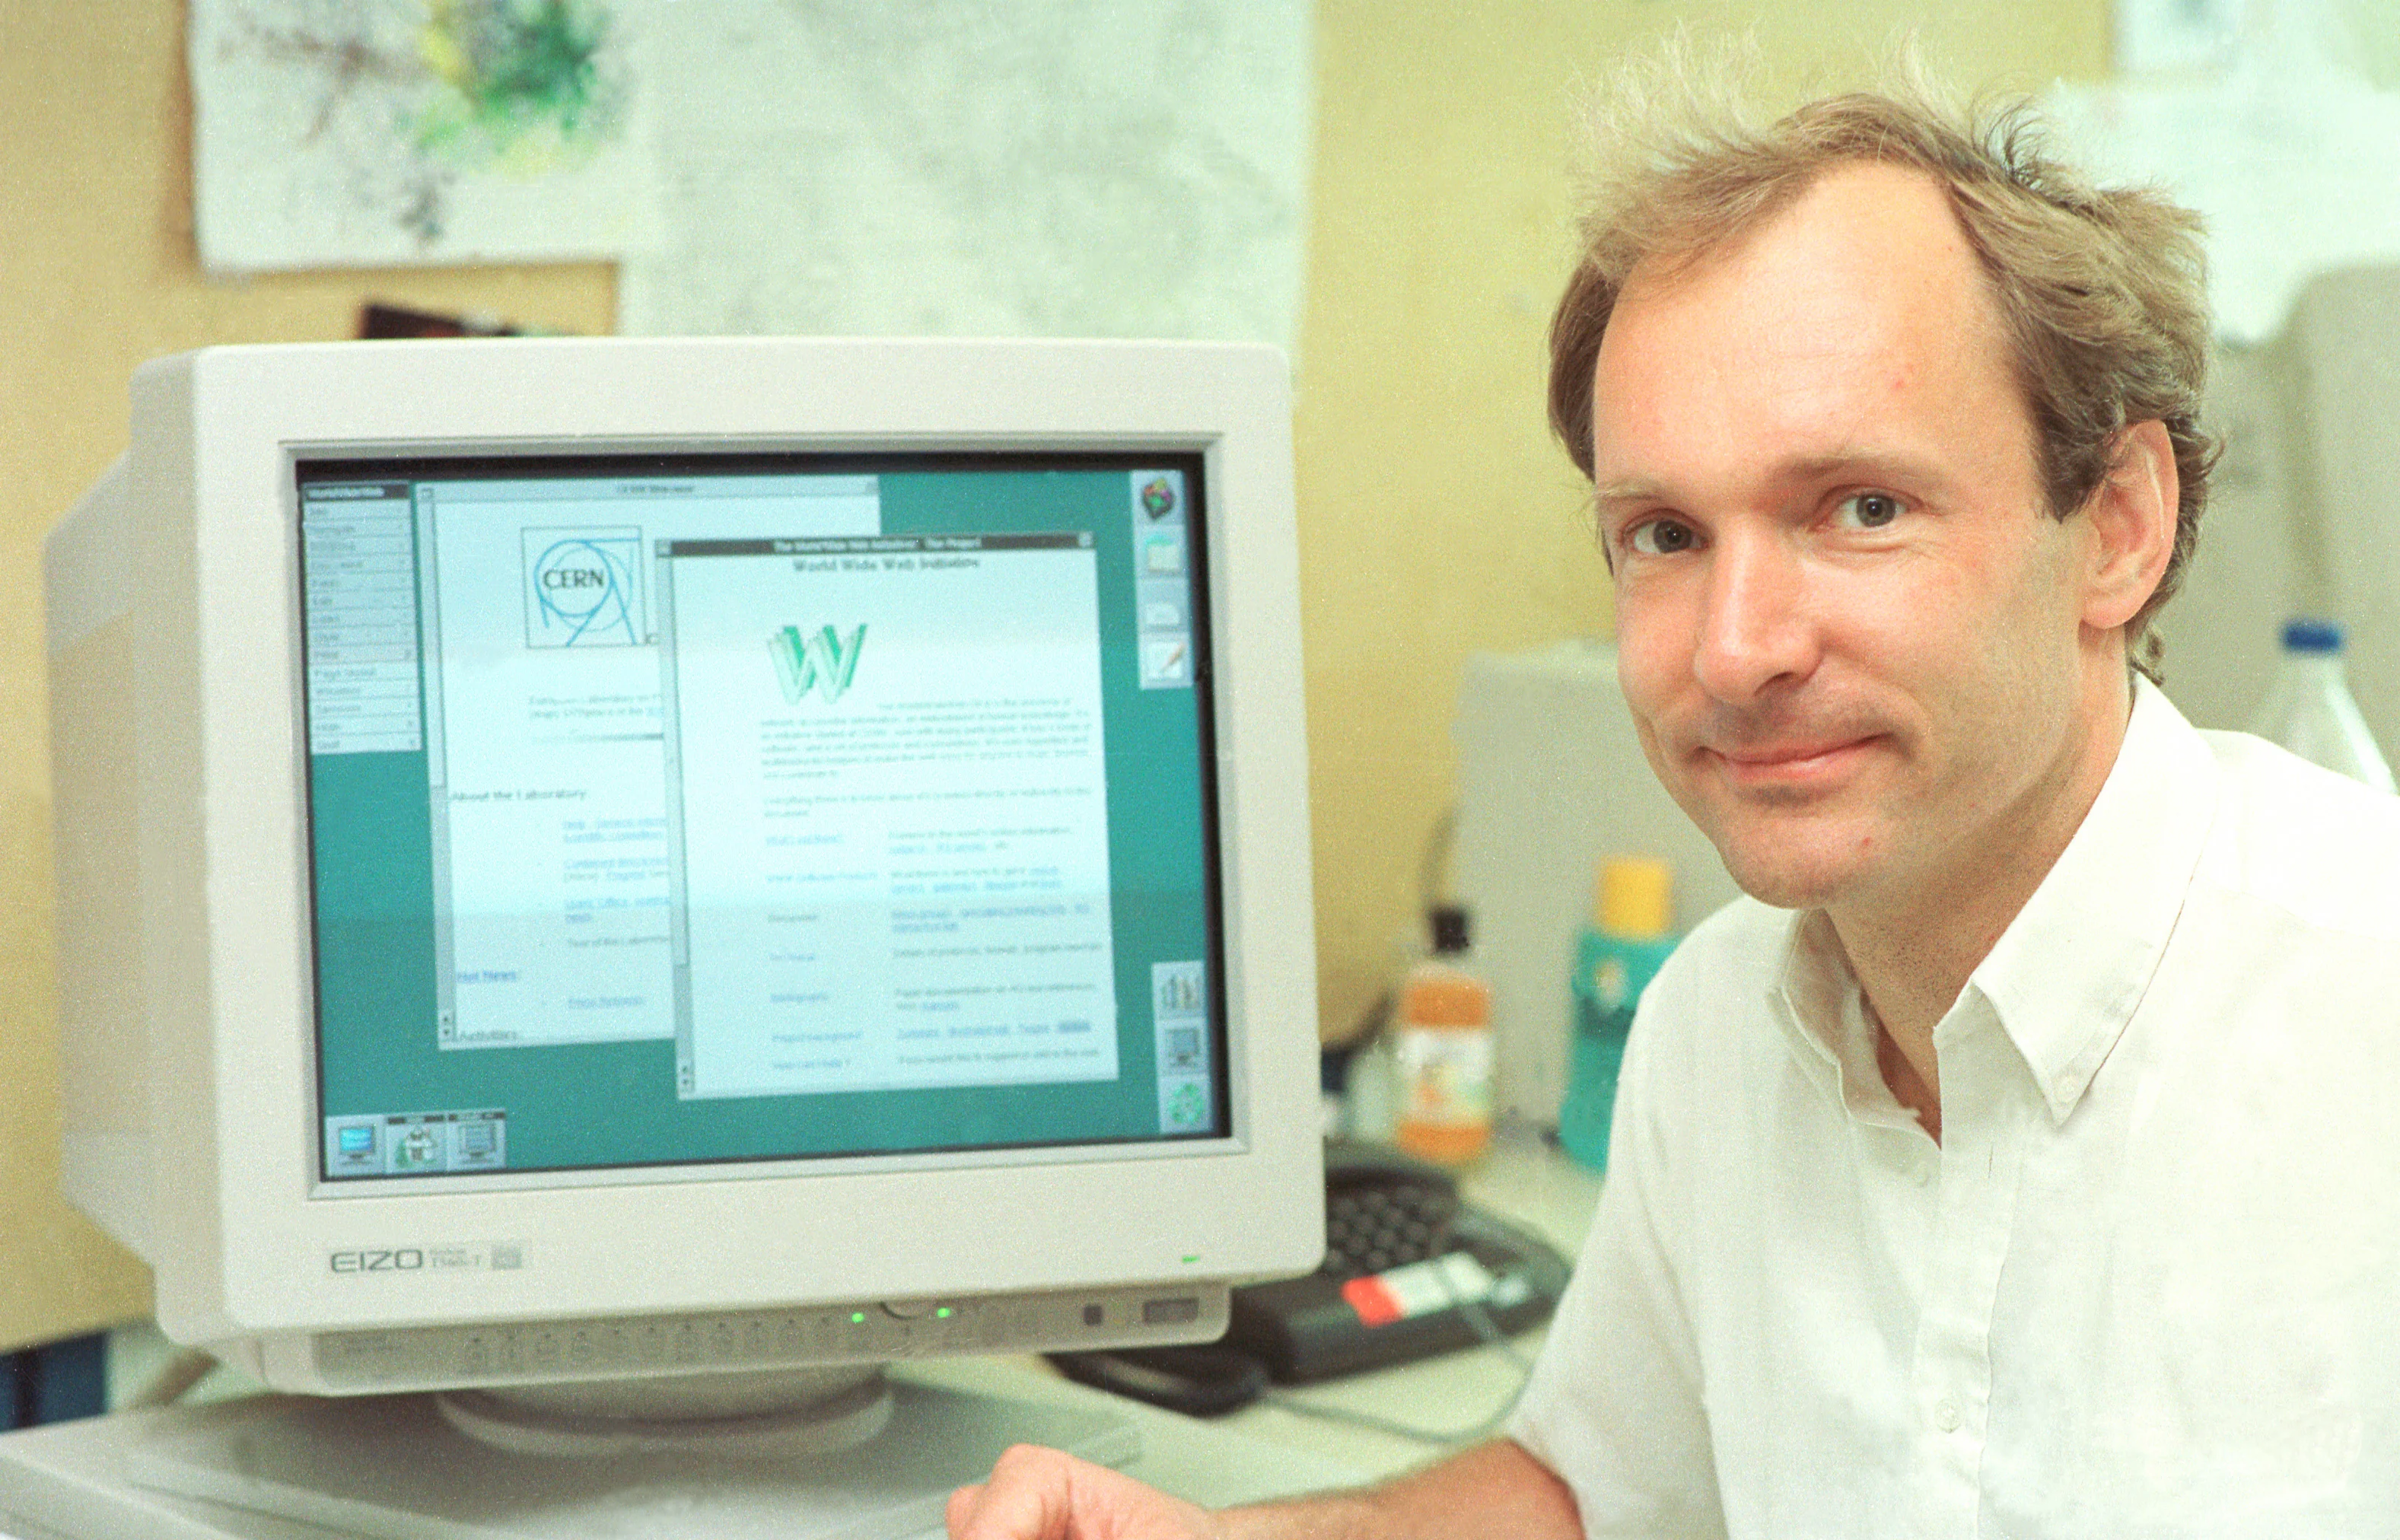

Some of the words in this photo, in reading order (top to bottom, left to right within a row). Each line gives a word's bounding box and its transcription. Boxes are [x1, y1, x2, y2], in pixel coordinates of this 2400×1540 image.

[794, 558, 837, 571] World
[840, 558, 878, 571] Wide
[882, 558, 915, 571] Web
[543, 568, 604, 590] CERN
[454, 791, 489, 800] About
[492, 790, 513, 800] the
[330, 1249, 424, 1274] EIZO
